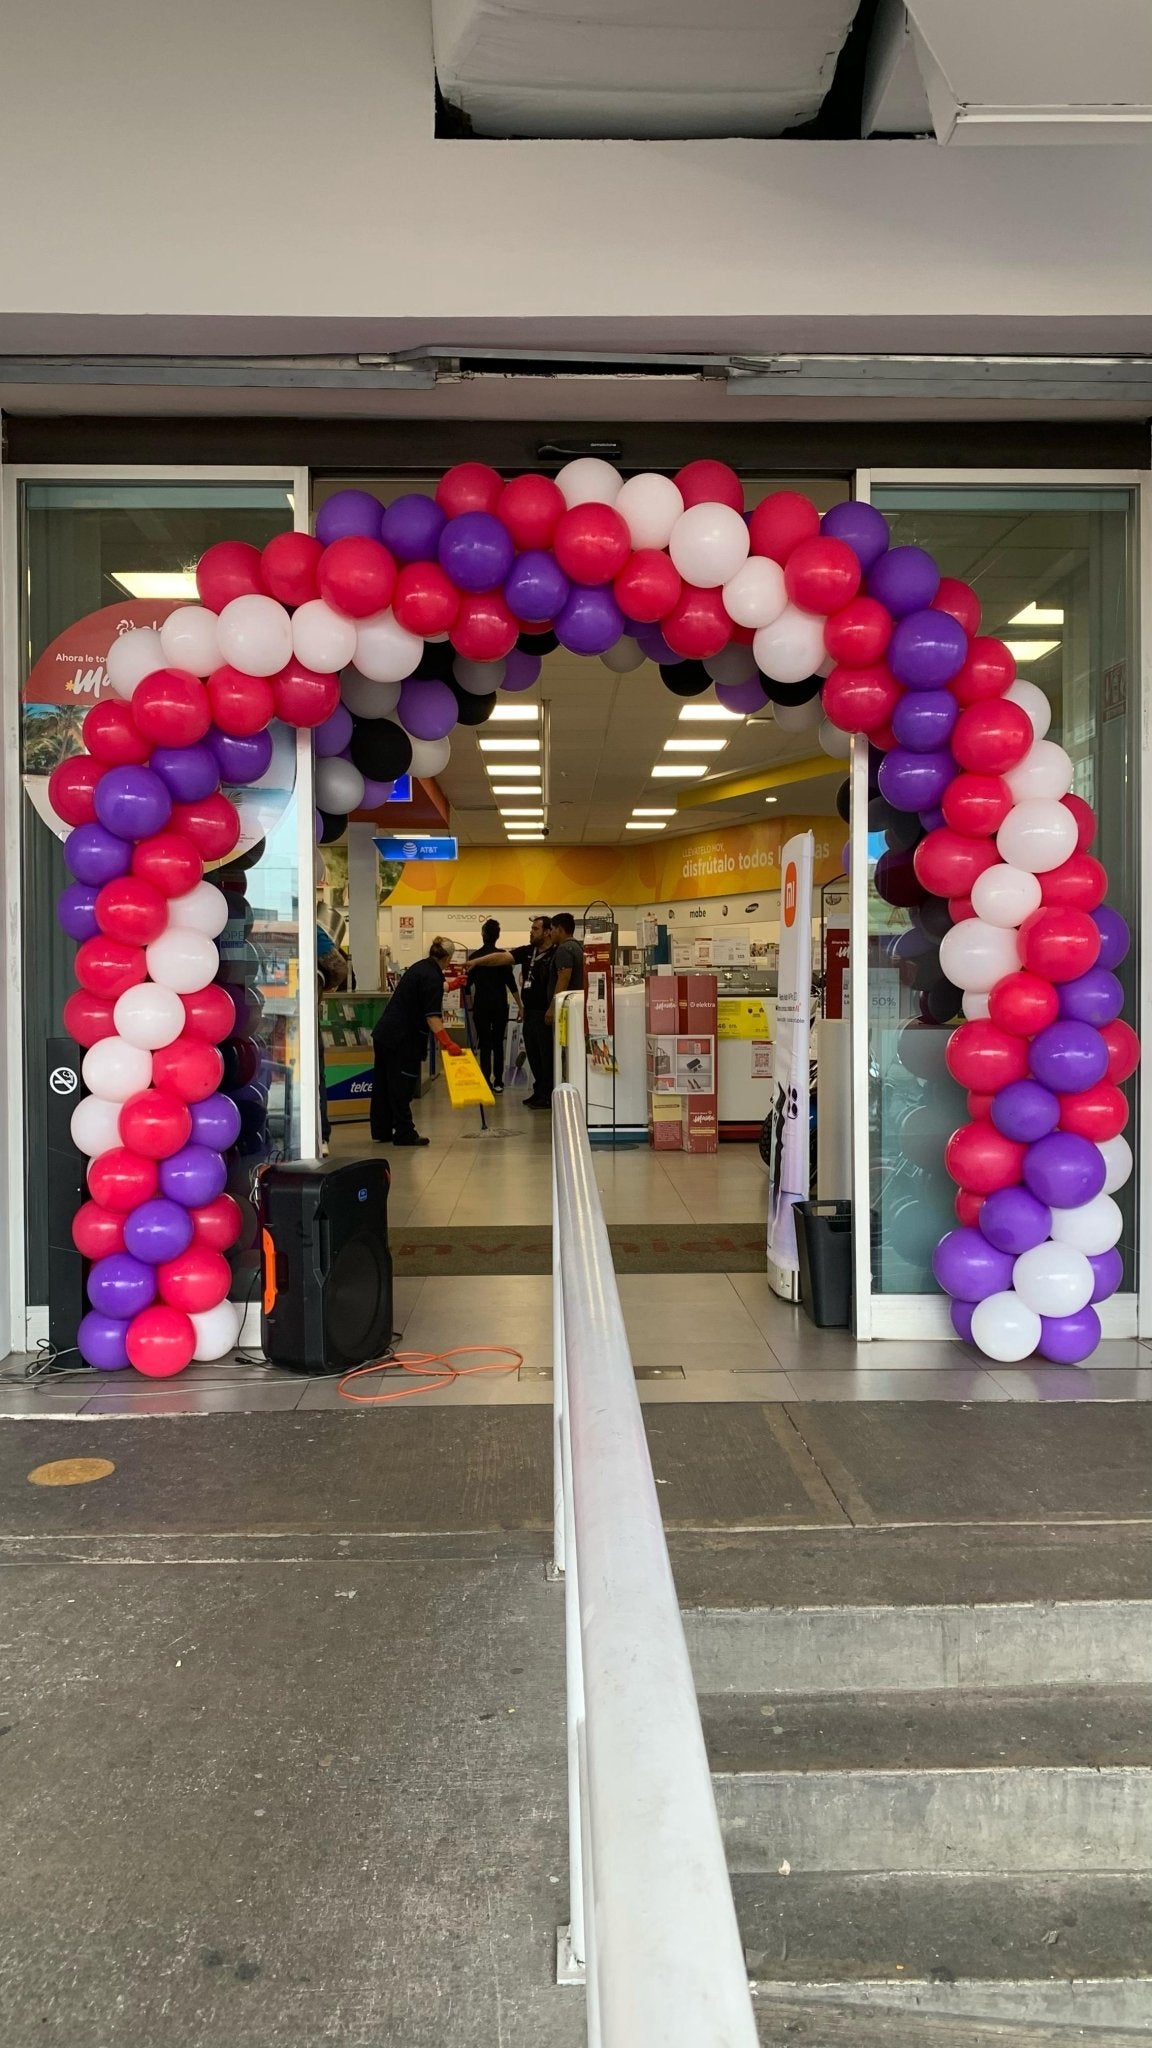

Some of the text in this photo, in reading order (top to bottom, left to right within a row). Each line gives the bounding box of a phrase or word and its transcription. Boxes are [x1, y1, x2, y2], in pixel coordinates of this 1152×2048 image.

[55, 653, 84, 663] Ahora
[85, 654, 94, 663] le
[419, 846, 438, 854] AT&T
[682, 854, 735, 878] disfrútalo
[738, 848, 774, 870] todos
[814, 842, 830, 860] as
[689, 907, 707, 918] mabe
[872, 997, 897, 1007] 50%
[350, 1081, 373, 1094] telce
